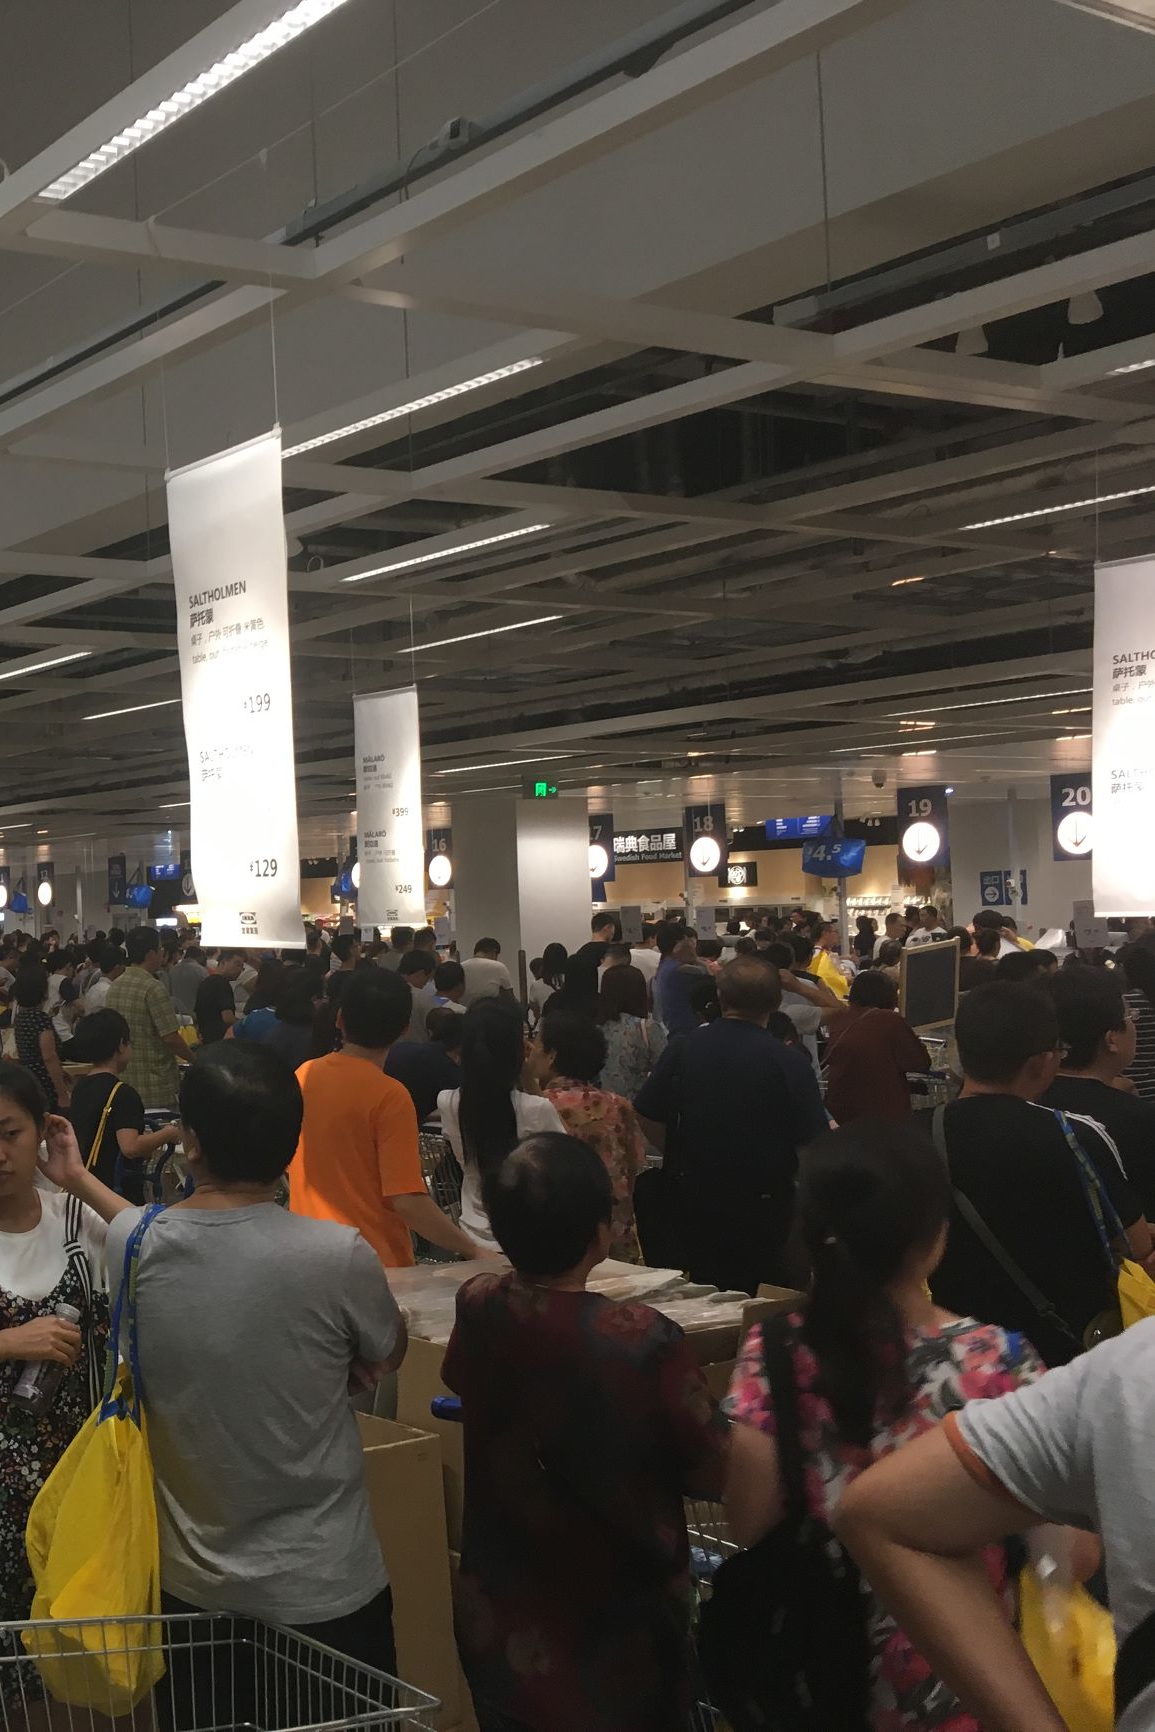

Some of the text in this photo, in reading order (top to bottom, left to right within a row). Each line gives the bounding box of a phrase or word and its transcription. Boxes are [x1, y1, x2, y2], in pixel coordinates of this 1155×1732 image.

[189, 580, 246, 609] SALTHOLMEN
[1112, 664, 1147, 679] 萨托蒙
[1061, 786, 1092, 807] 20
[908, 799, 933, 817] 19
[694, 815, 714, 832] 18
[589, 825, 602, 840] 7
[432, 838, 447, 852] 16
[613, 833, 676, 853] 瑞典食品屋
[614, 853, 639, 862] Swedish
[659, 851, 682, 859] Market
[249, 858, 278, 877] ¥129
